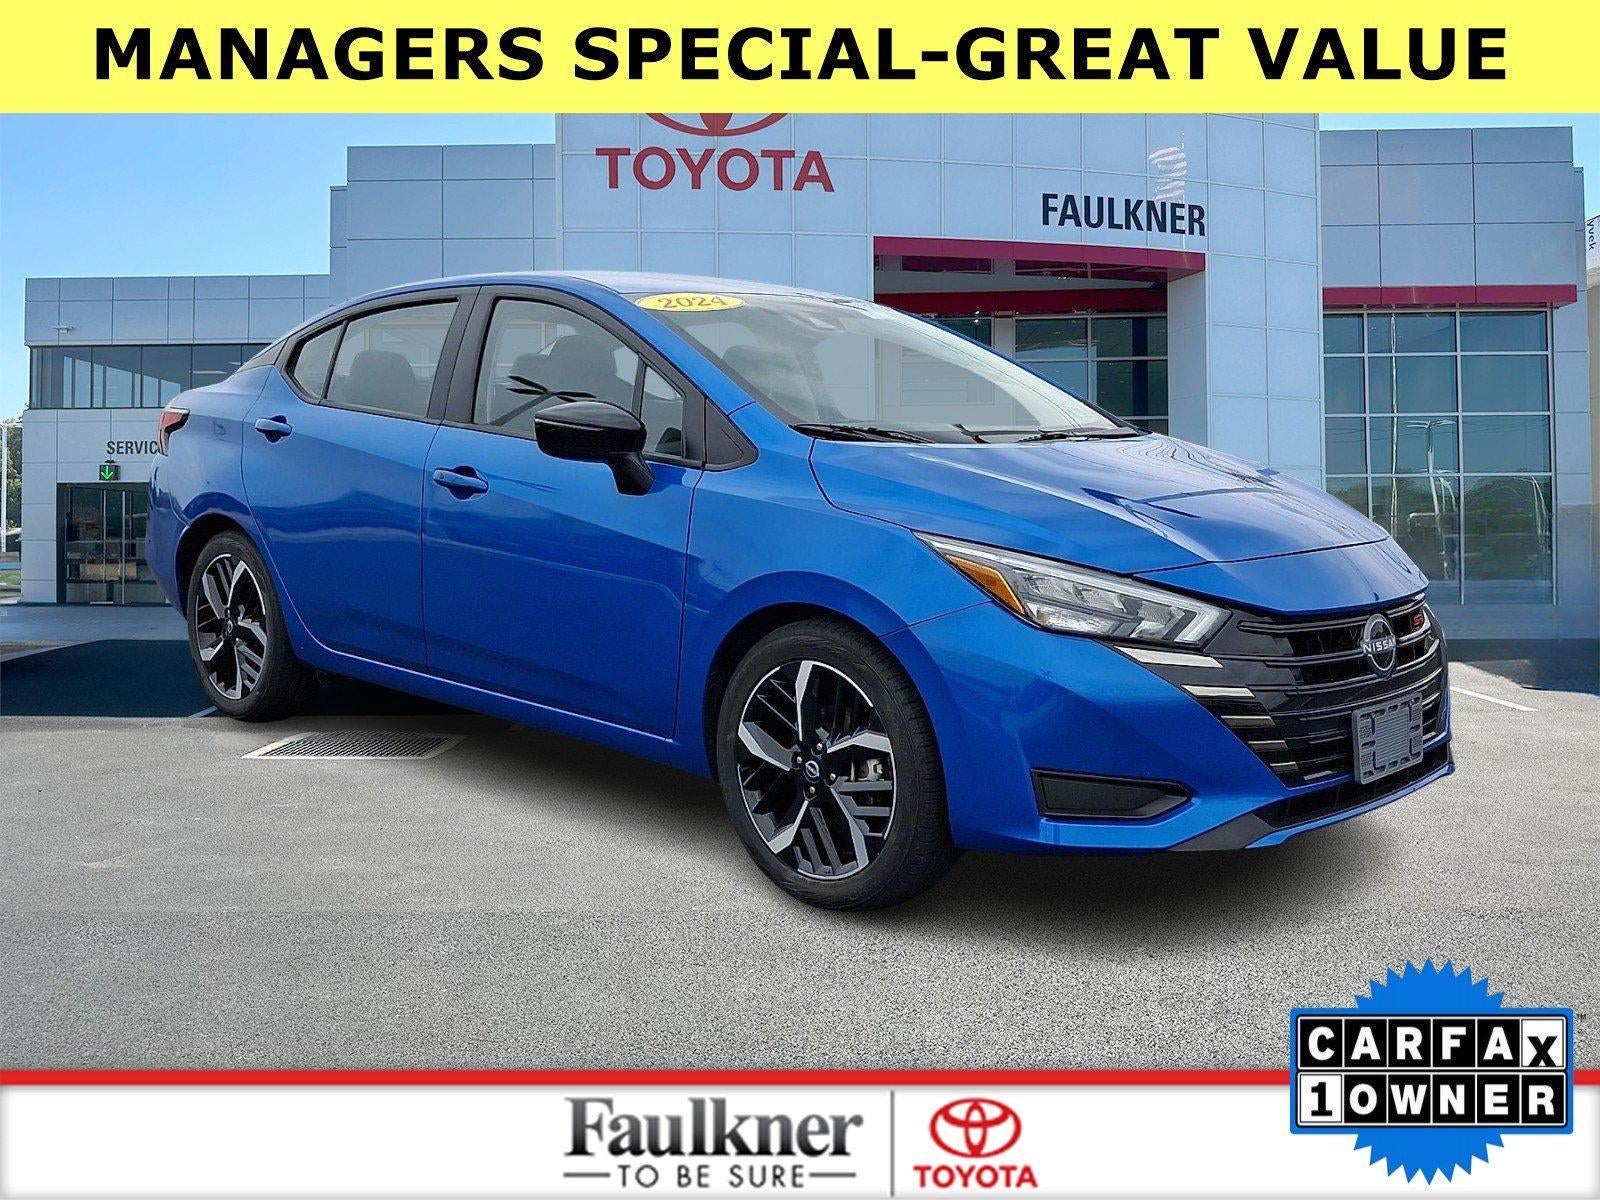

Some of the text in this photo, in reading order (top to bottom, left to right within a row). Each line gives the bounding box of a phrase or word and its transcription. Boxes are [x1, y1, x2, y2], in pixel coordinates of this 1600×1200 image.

[596, 146, 835, 193] TOYOTA
[1041, 193, 1206, 237] FAULKNER
[1587, 219, 1597, 251] yvek
[658, 296, 727, 309] 2024
[106, 440, 158, 454] SERVIC
